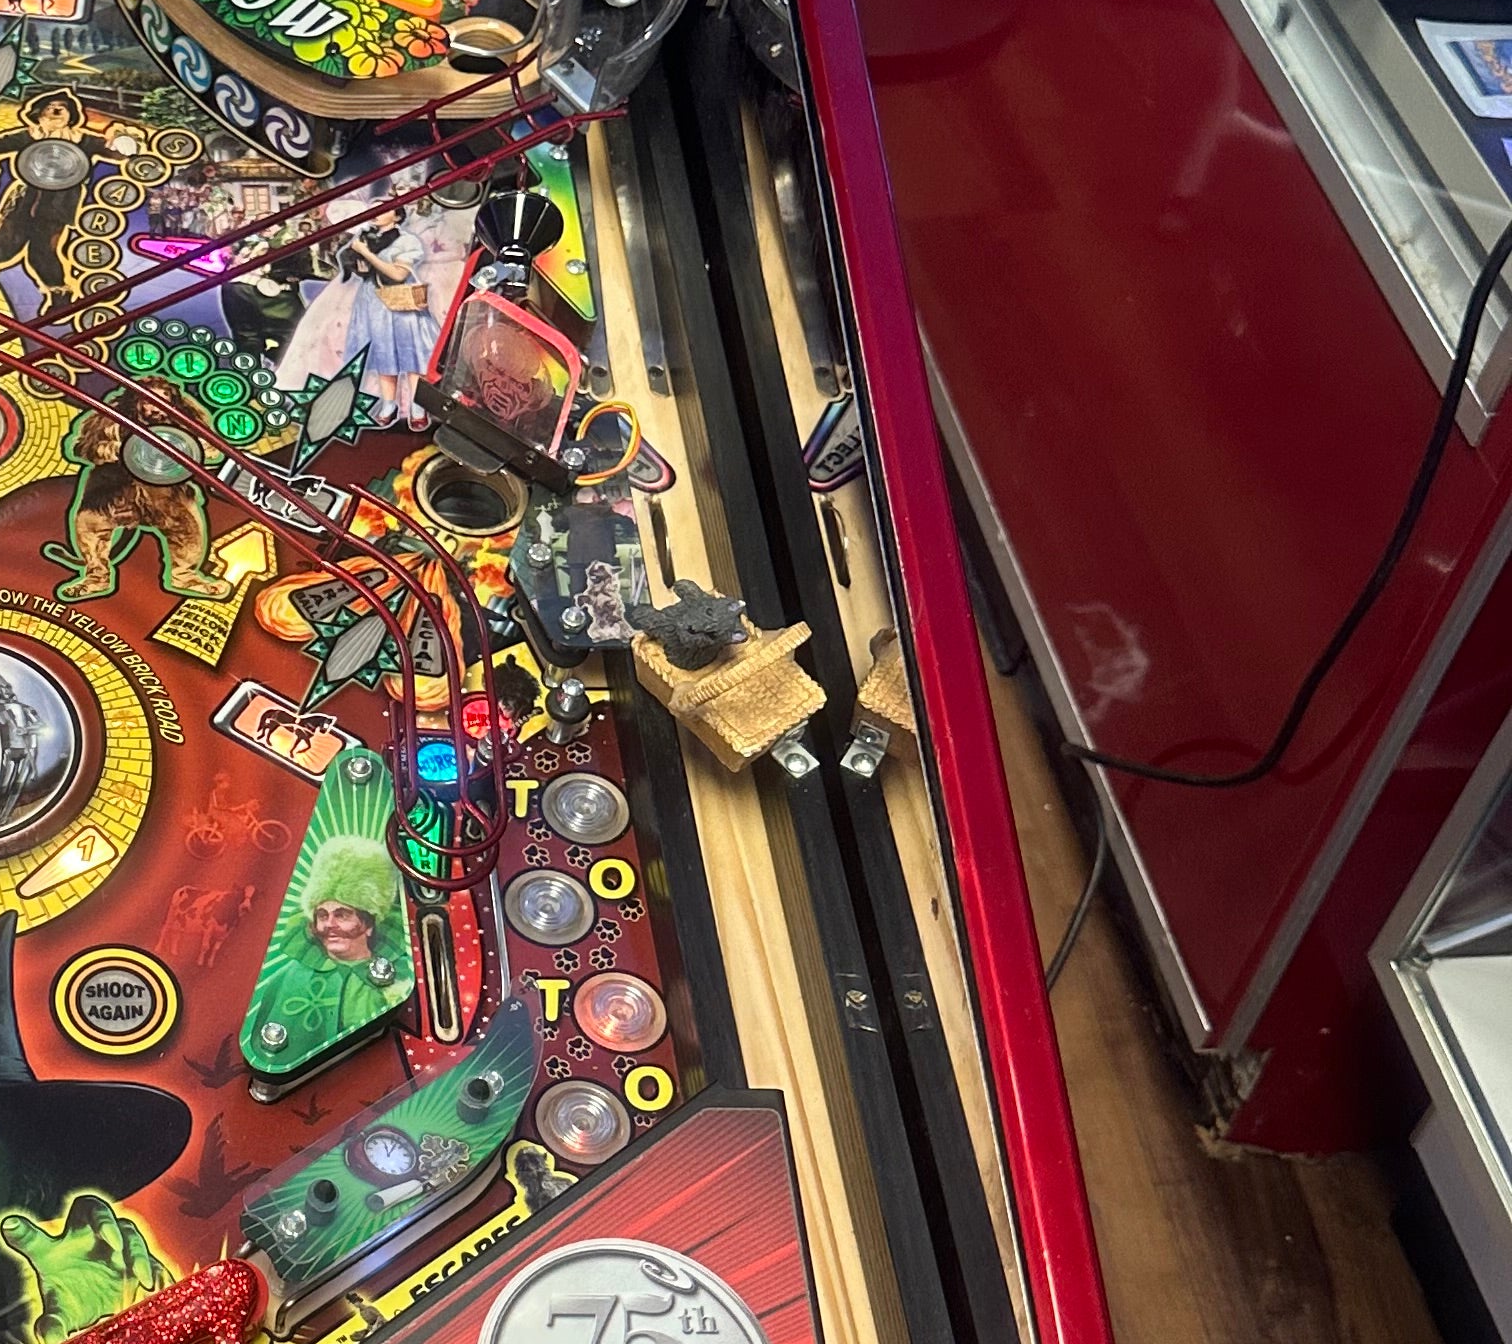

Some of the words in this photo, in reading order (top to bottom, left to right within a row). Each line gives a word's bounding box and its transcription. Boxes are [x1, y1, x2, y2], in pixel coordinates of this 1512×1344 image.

[184, 603, 229, 627] ADVANCE
[294, 593, 317, 619] BALL
[169, 619, 221, 646] BRICK
[177, 610, 227, 637] YELLOW
[163, 627, 216, 653] ROAD
[33, 596, 66, 618] THE
[68, 609, 133, 658] YELLOW
[121, 651, 167, 702] BRICK
[149, 694, 185, 745] ROAD
[77, 834, 97, 861] 1
[86, 983, 146, 999] SHOOT
[88, 1003, 145, 1021] AGAIN
